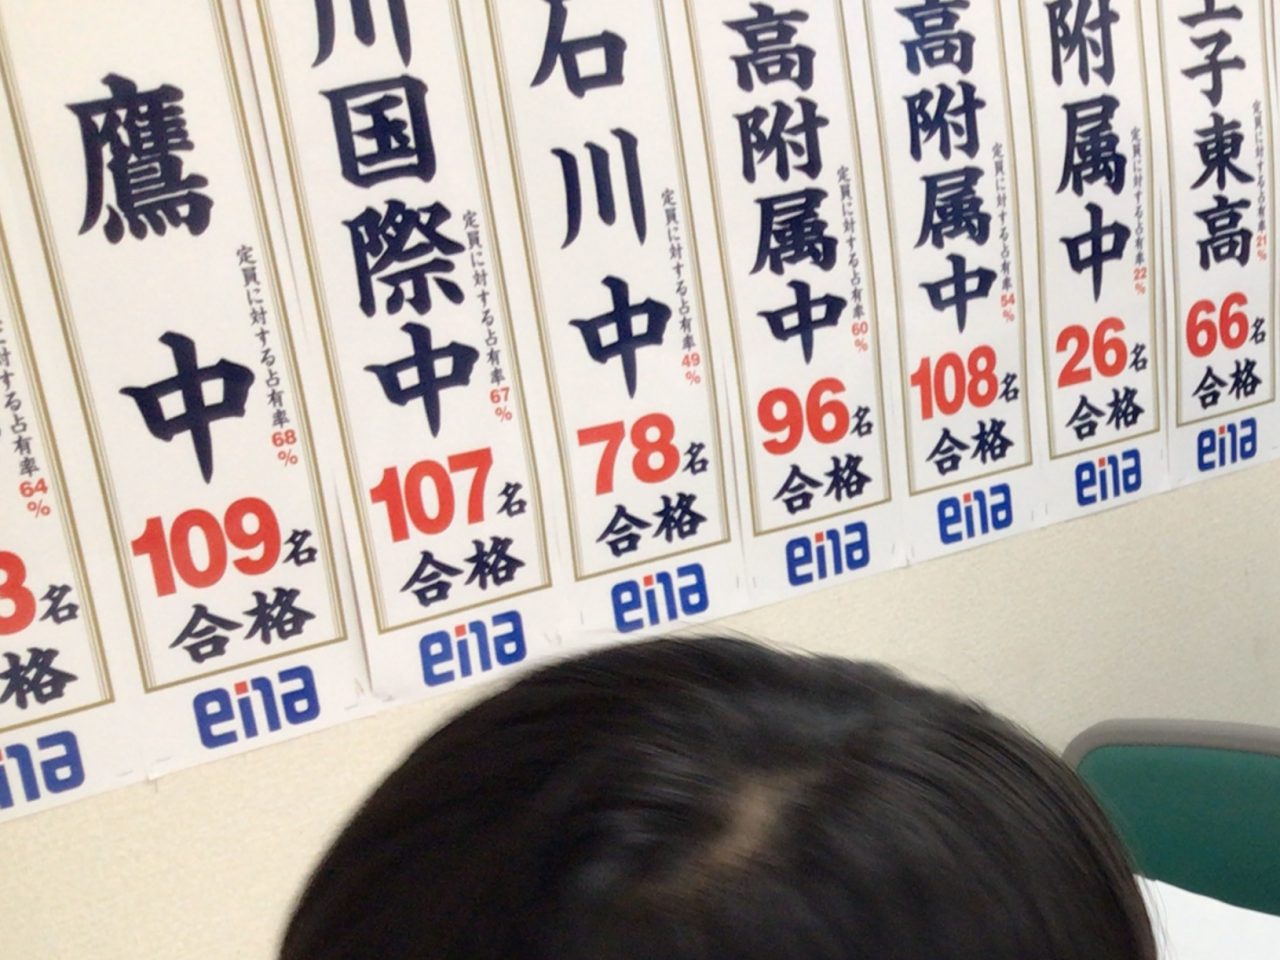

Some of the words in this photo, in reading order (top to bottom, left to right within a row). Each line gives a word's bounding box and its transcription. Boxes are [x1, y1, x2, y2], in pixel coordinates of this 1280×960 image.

[723, 2, 847, 365] 高附属中
[894, 0, 998, 335] 高附属中
[1044, 0, 1131, 303] 附属中
[66, 72, 255, 484] 鷹中
[1056, 317, 1148, 388] 26名
[1186, 292, 1266, 358] 66名
[757, 377, 873, 455] 96名
[910, 345, 1020, 420] 108名
[1066, 386, 1145, 441] 合格
[1192, 358, 1262, 409] 合格
[577, 412, 709, 496] 78名
[926, 418, 1014, 475] 合格
[369, 447, 528, 543] 107名
[773, 454, 872, 515] 合格
[131, 497, 317, 597] 109名
[596, 492, 707, 557] 合格
[400, 536, 525, 607] 合格
[169, 587, 316, 663] 合格
